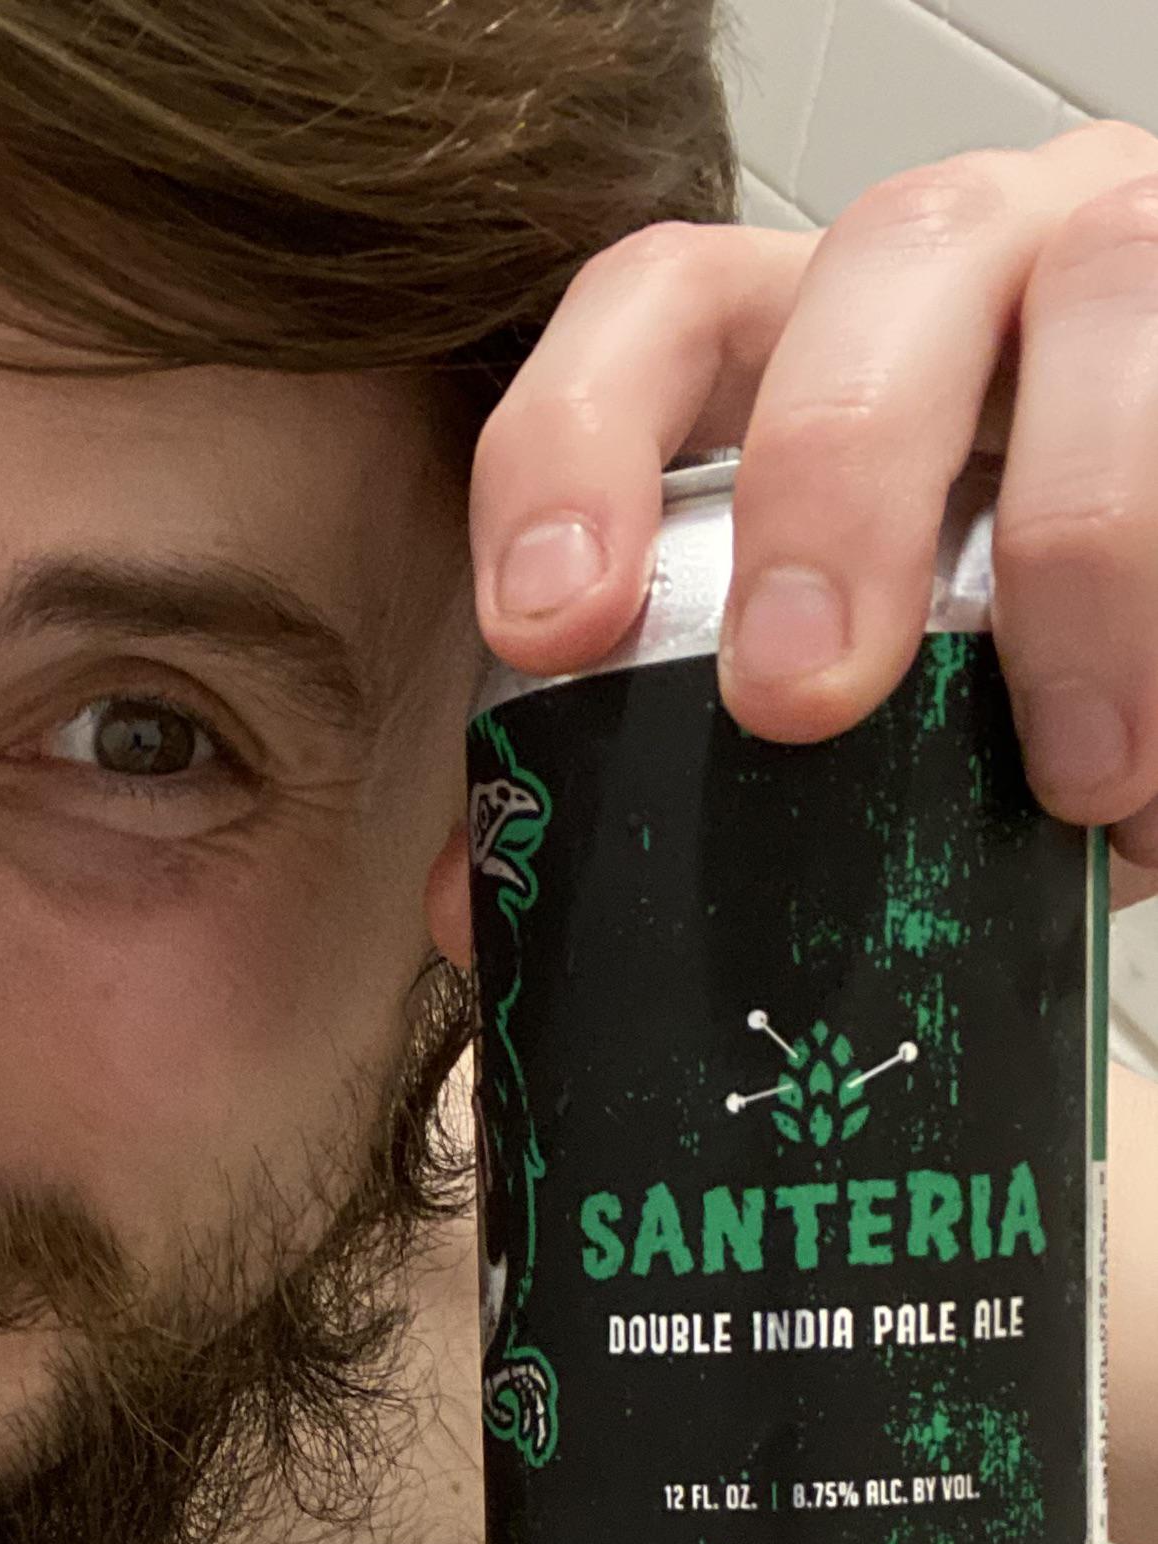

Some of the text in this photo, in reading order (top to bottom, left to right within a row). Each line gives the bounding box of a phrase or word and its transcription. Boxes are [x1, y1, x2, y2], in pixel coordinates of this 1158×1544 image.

[579, 1161, 1047, 1280] SANTERIA
[609, 1296, 1025, 1355] DOUBLE INDIA PALE ALE
[664, 1474, 980, 1510] 12 FL. OZ. 8.75% ALC. BY VOL.
